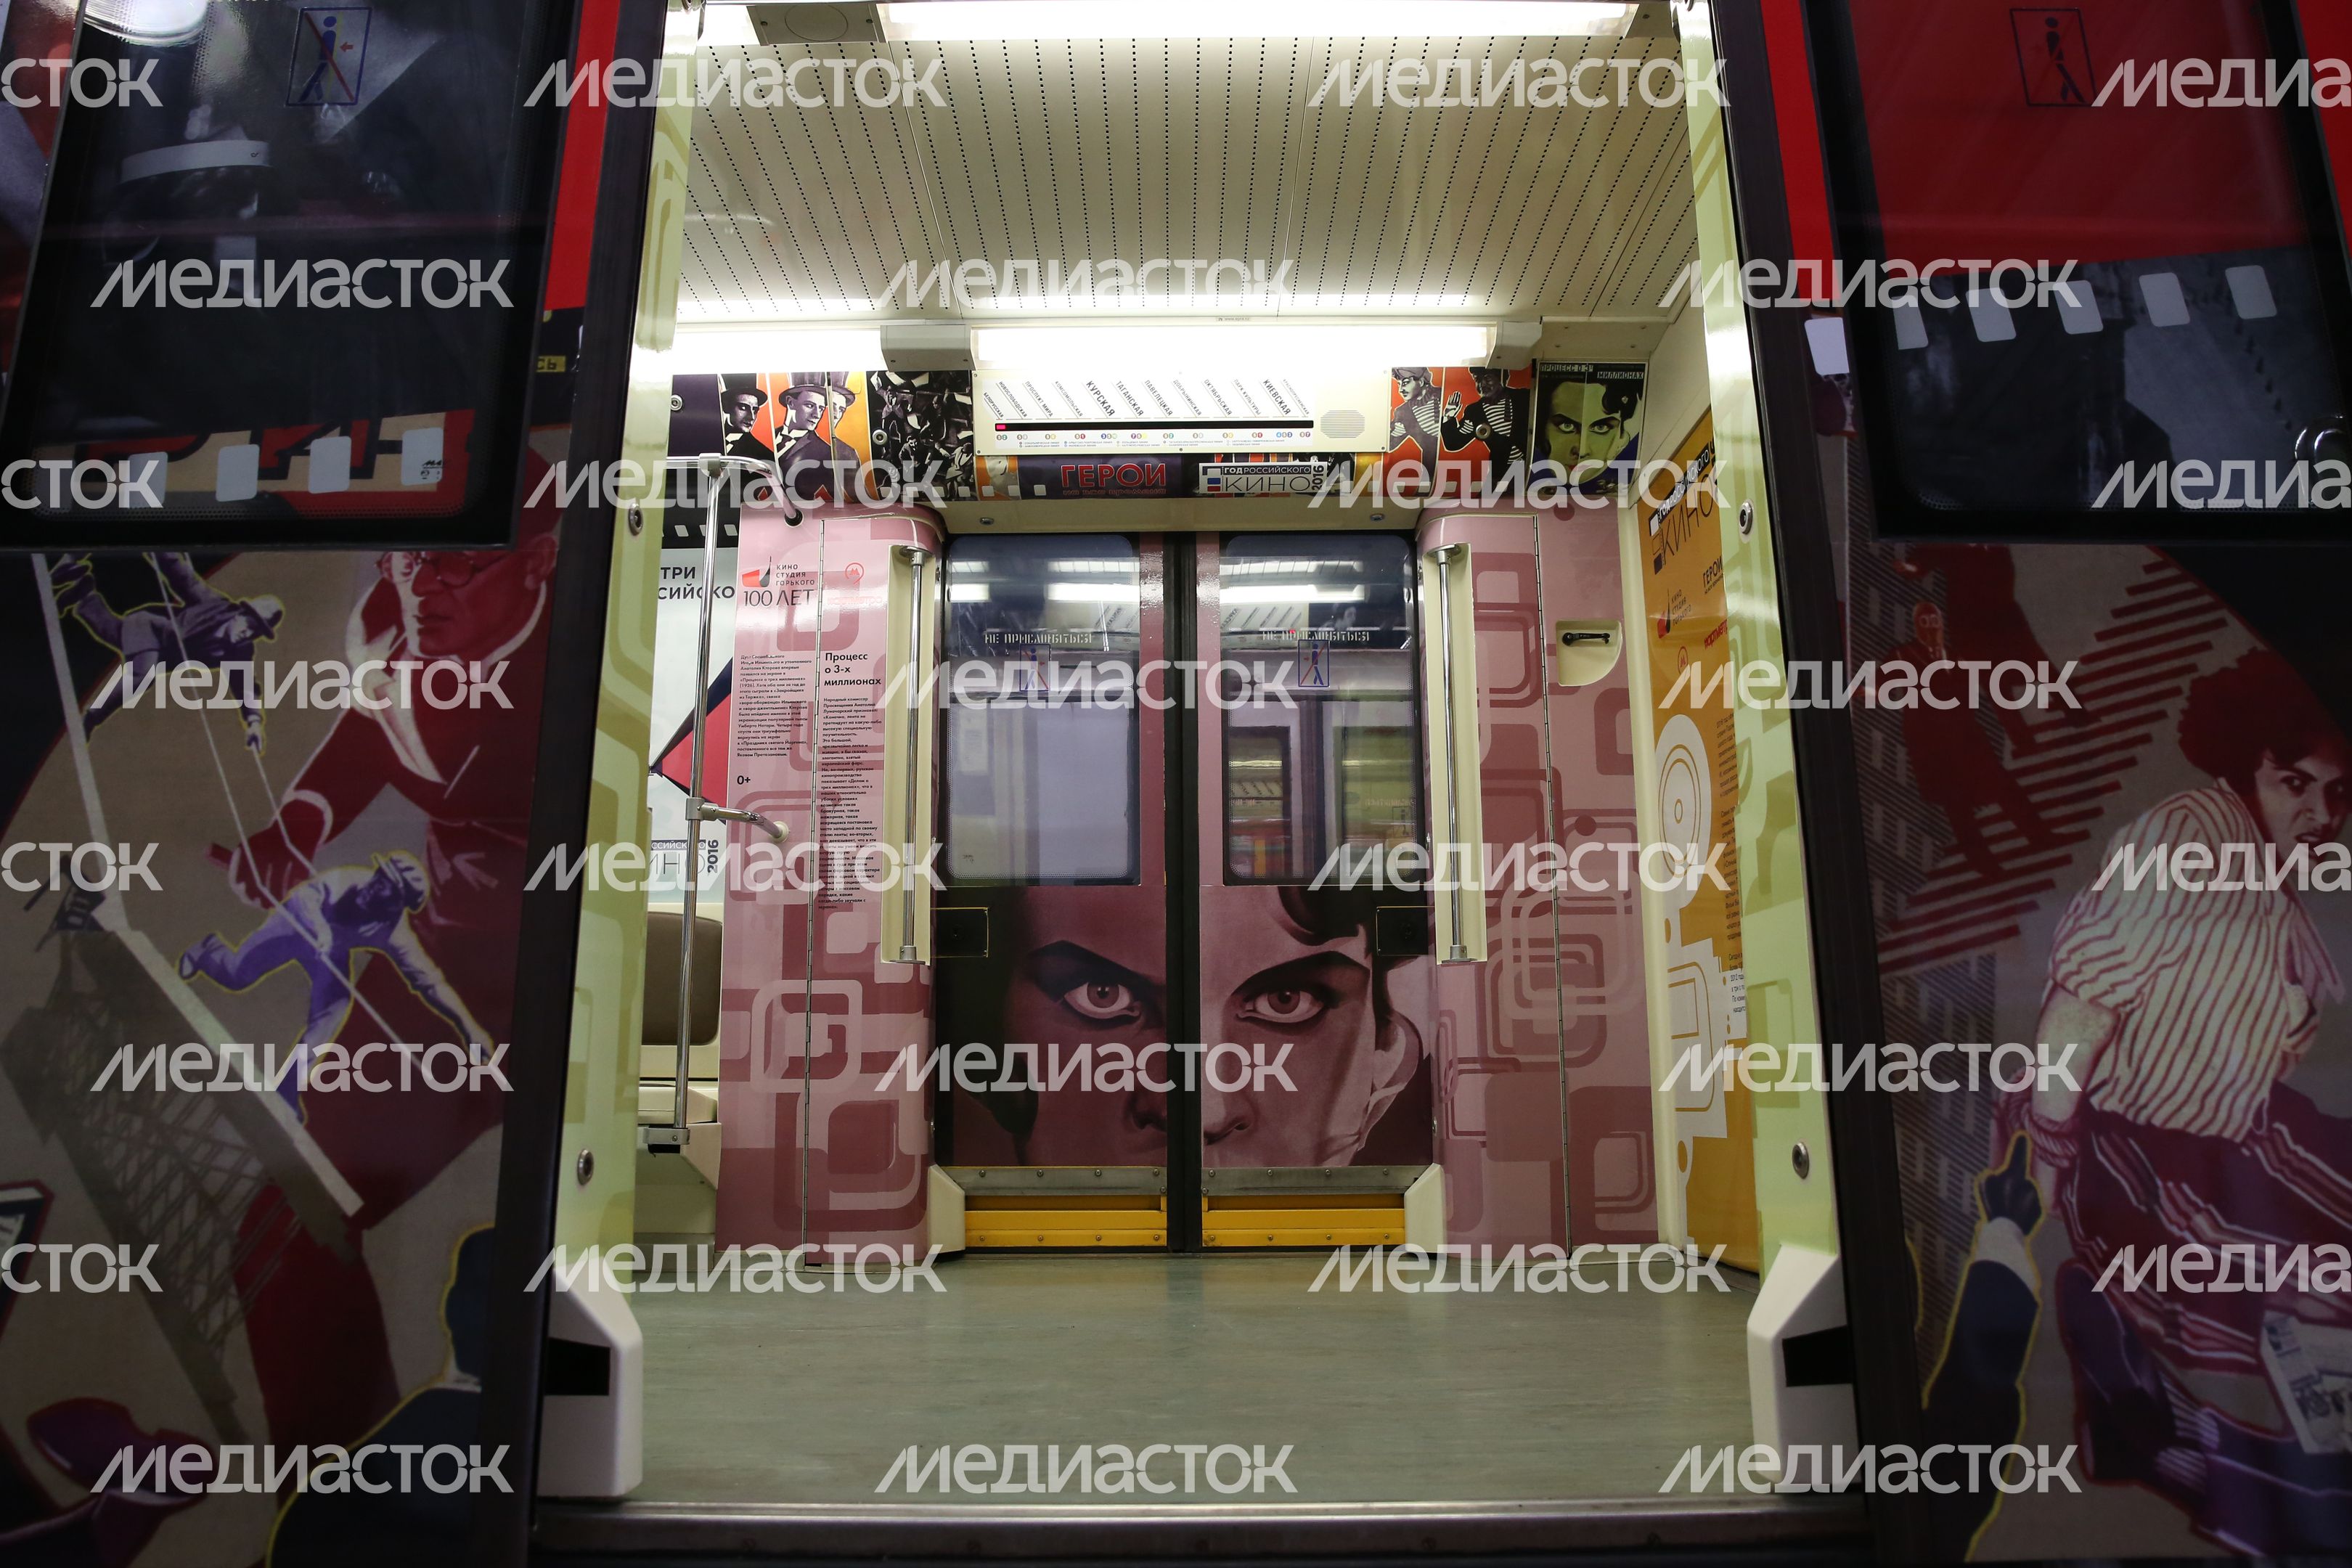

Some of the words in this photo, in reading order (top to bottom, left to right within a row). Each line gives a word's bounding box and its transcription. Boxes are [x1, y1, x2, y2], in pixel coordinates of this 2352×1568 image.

[984, 392, 1004, 417] БЕЛОРУССКАЯ
[998, 381, 1027, 417] НОВОСЛОБОДСКАЯ
[1025, 381, 1044, 404] ПРОСПЕКТ
[1042, 404, 1053, 417] МИРА
[1055, 381, 1083, 417] КОМСОМОЛЬСКАЯ
[1086, 380, 1115, 416] КУРСКАЯ
[1116, 380, 1144, 416] ТАГАНСКАЯ
[1145, 380, 1173, 416] ПАВЕЛЕЦКАЯ
[1173, 379, 1201, 416] ДОБРЫНИНСКАЯ
[1204, 379, 1232, 416] ОКТЯБРЬСКАЯ
[1234, 379, 1244, 391] ПАРК
[1242, 391, 1261, 415] КУЛЬТУРЫ
[1263, 379, 1291, 415] КИЕВСКАЯ
[1061, 463, 1166, 487] ГЕРОИ
[1225, 476, 1311, 492] КИНО
[1243, 465, 1311, 474] РОССИЙСКОГО
[1312, 465, 1325, 491] 2016
[1661, 473, 1713, 565] КИНО
[660, 566, 696, 579] ТРИ
[743, 589, 772, 607] 100
[776, 589, 814, 606] ЛЕТ
[984, 633, 1000, 644] НЕ
[1262, 631, 1277, 641] НЕ
[825, 653, 868, 663] Процесс
[834, 665, 851, 674] 3-х
[737, 775, 751, 785] 0+
[707, 839, 719, 874] 2016
